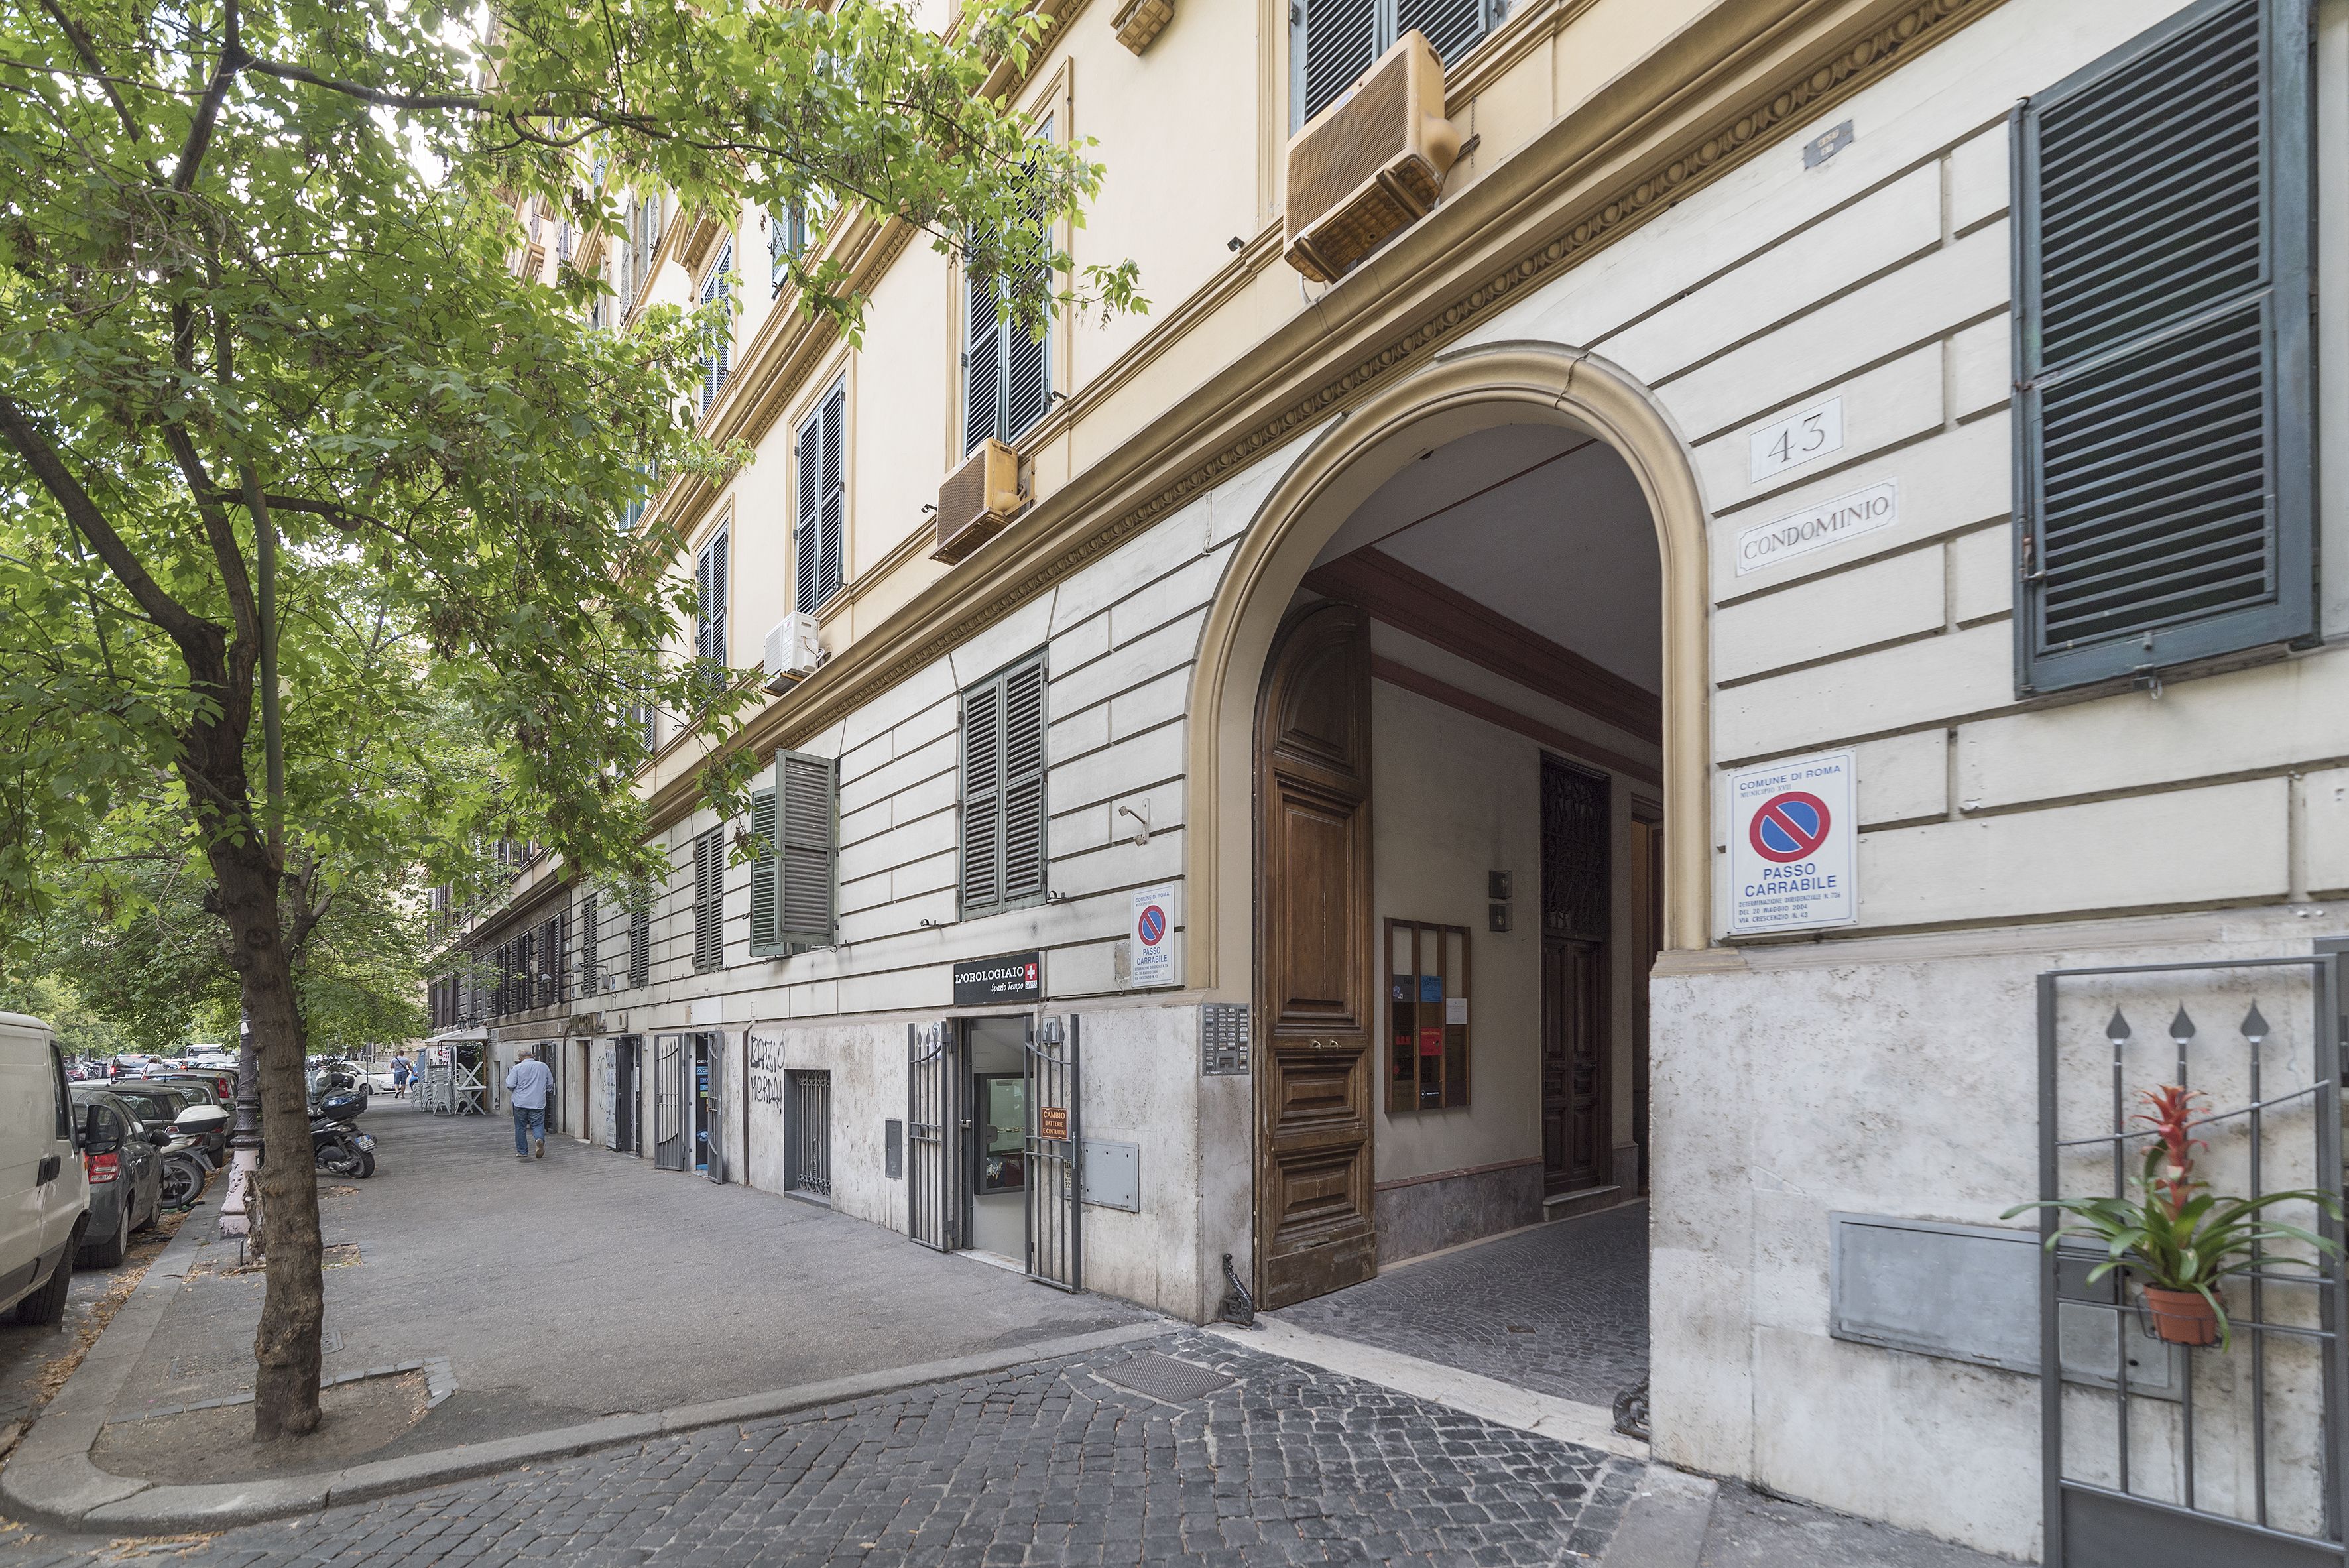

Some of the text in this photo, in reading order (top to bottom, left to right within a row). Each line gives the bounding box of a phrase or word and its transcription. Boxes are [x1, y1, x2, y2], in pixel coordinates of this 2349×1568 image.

[1768, 412, 1825, 463] 43
[1744, 496, 1889, 560] CONDOMINIO
[1739, 765, 1841, 790] COMUNE DI ROMA
[1764, 863, 1816, 880] PASSO
[1745, 875, 1837, 898] CARRABILE
[1142, 946, 1161, 955] PASSO
[1136, 955, 1168, 965] CARRABILE
[955, 966, 1024, 984] L'OROLOGIAIO
[991, 981, 1024, 995] Spazio Tempo
[1043, 1111, 1065, 1120] CAMBIO
